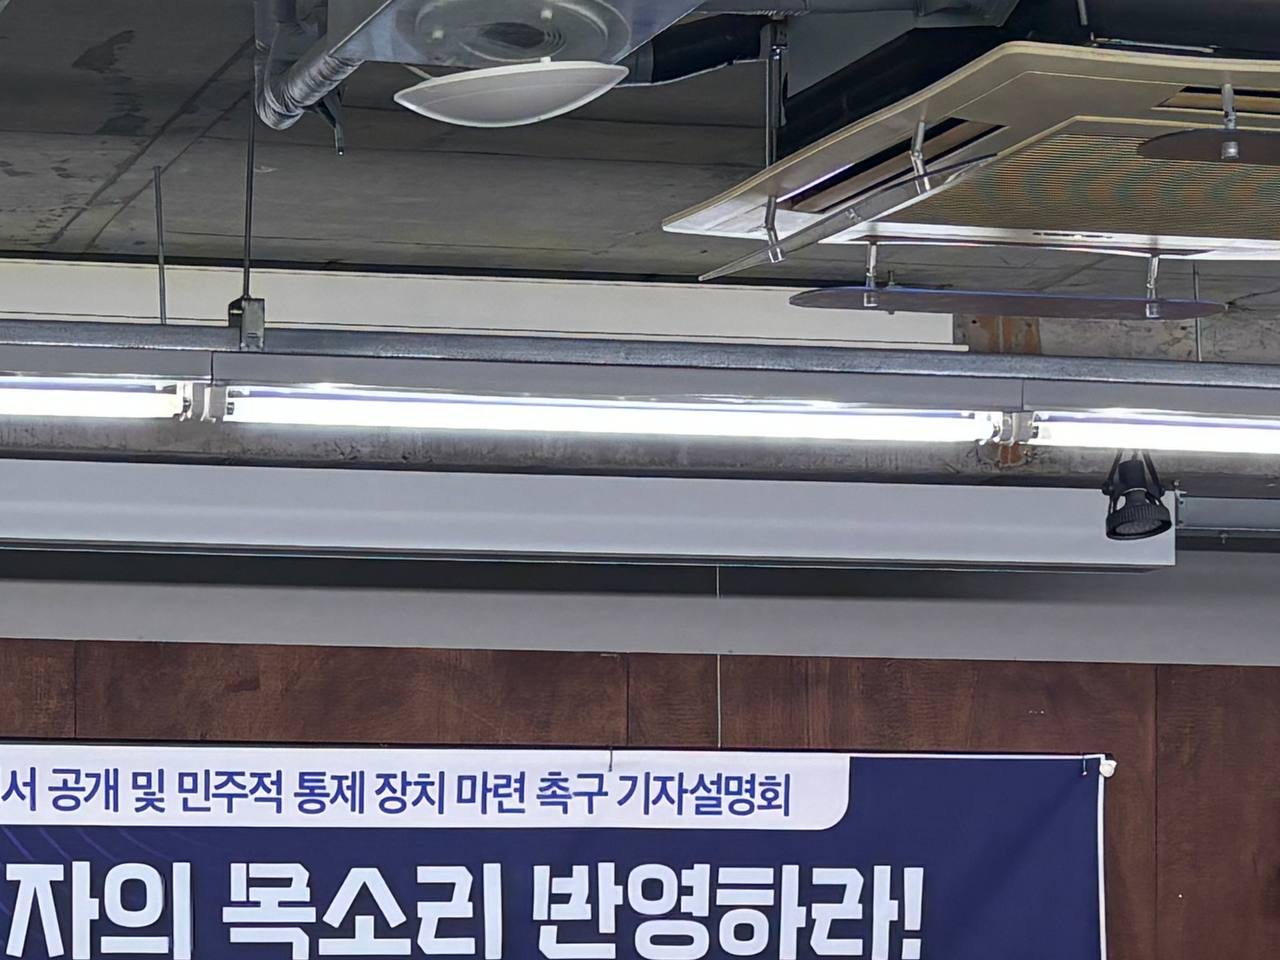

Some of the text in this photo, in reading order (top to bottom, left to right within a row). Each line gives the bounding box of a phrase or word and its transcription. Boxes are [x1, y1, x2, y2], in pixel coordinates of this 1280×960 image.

[48, 768, 118, 812] 공개
[132, 769, 165, 812] 및
[178, 769, 282, 813] 민주적
[294, 771, 364, 814] 통제
[375, 771, 445, 814] 장치
[457, 771, 525, 814] 마련
[536, 772, 607, 814] 촉구
[617, 772, 790, 816] 기자설명회
[6, 861, 191, 960] 자의
[223, 863, 502, 960] 목소리
[533, 862, 923, 960] 반영하라!
